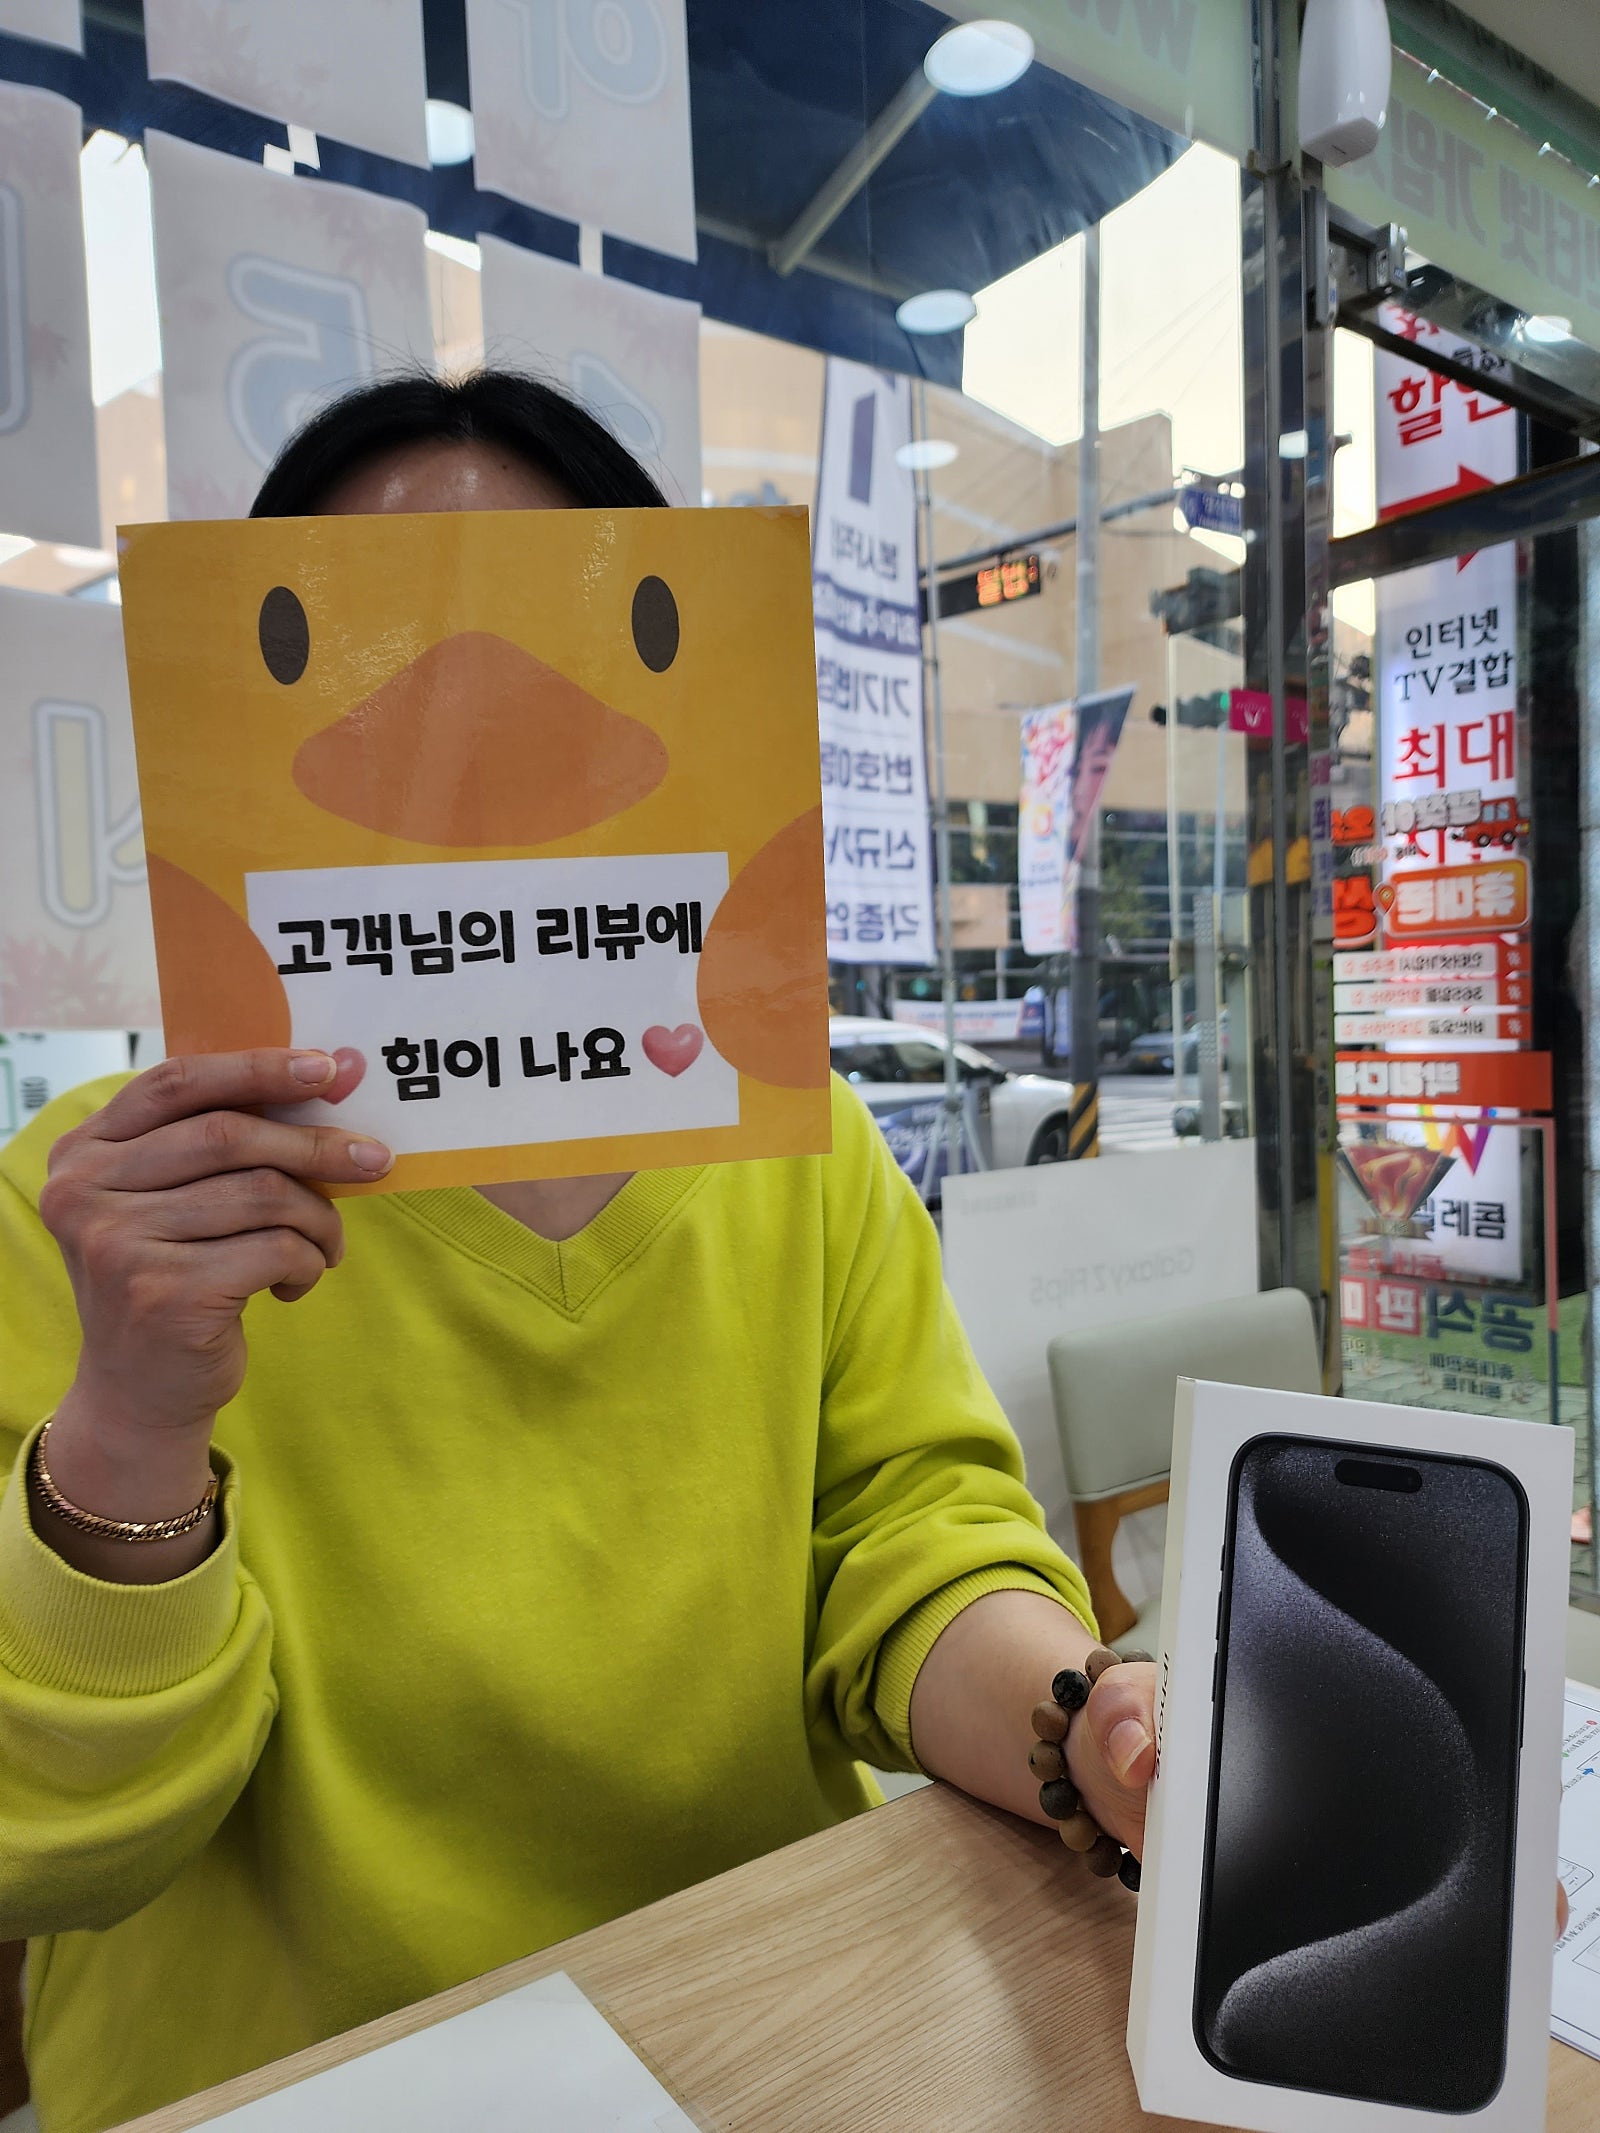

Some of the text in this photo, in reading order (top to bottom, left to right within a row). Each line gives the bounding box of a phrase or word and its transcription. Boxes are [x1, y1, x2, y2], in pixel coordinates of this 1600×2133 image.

[1405, 606, 1500, 660] 인터넷
[1394, 651, 1514, 702] TV결합
[1392, 709, 1516, 789] 최대
[277, 901, 703, 977] 고객님의 리뷰에
[380, 1028, 630, 1102] 힘이 나요
